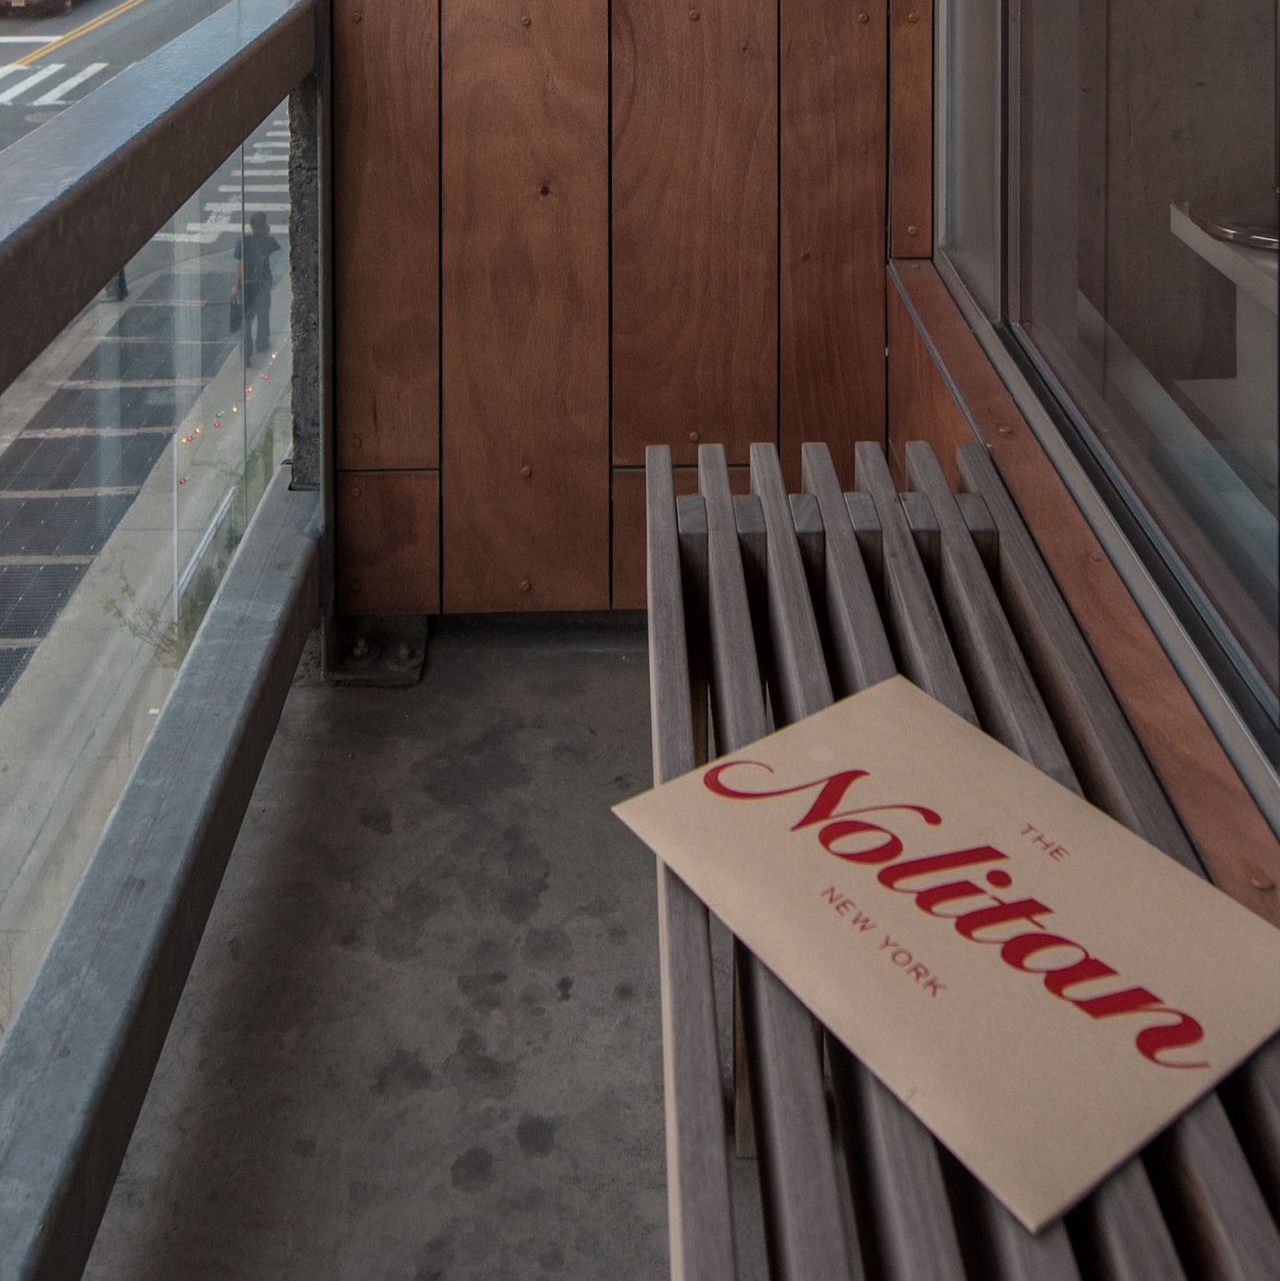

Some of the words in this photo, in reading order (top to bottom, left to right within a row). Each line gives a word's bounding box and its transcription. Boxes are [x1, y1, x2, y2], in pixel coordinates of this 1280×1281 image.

[1021, 823, 1071, 862] THE
[703, 759, 1211, 1070] Nolitan
[821, 886, 877, 932] NEW
[879, 934, 947, 998] YORK
